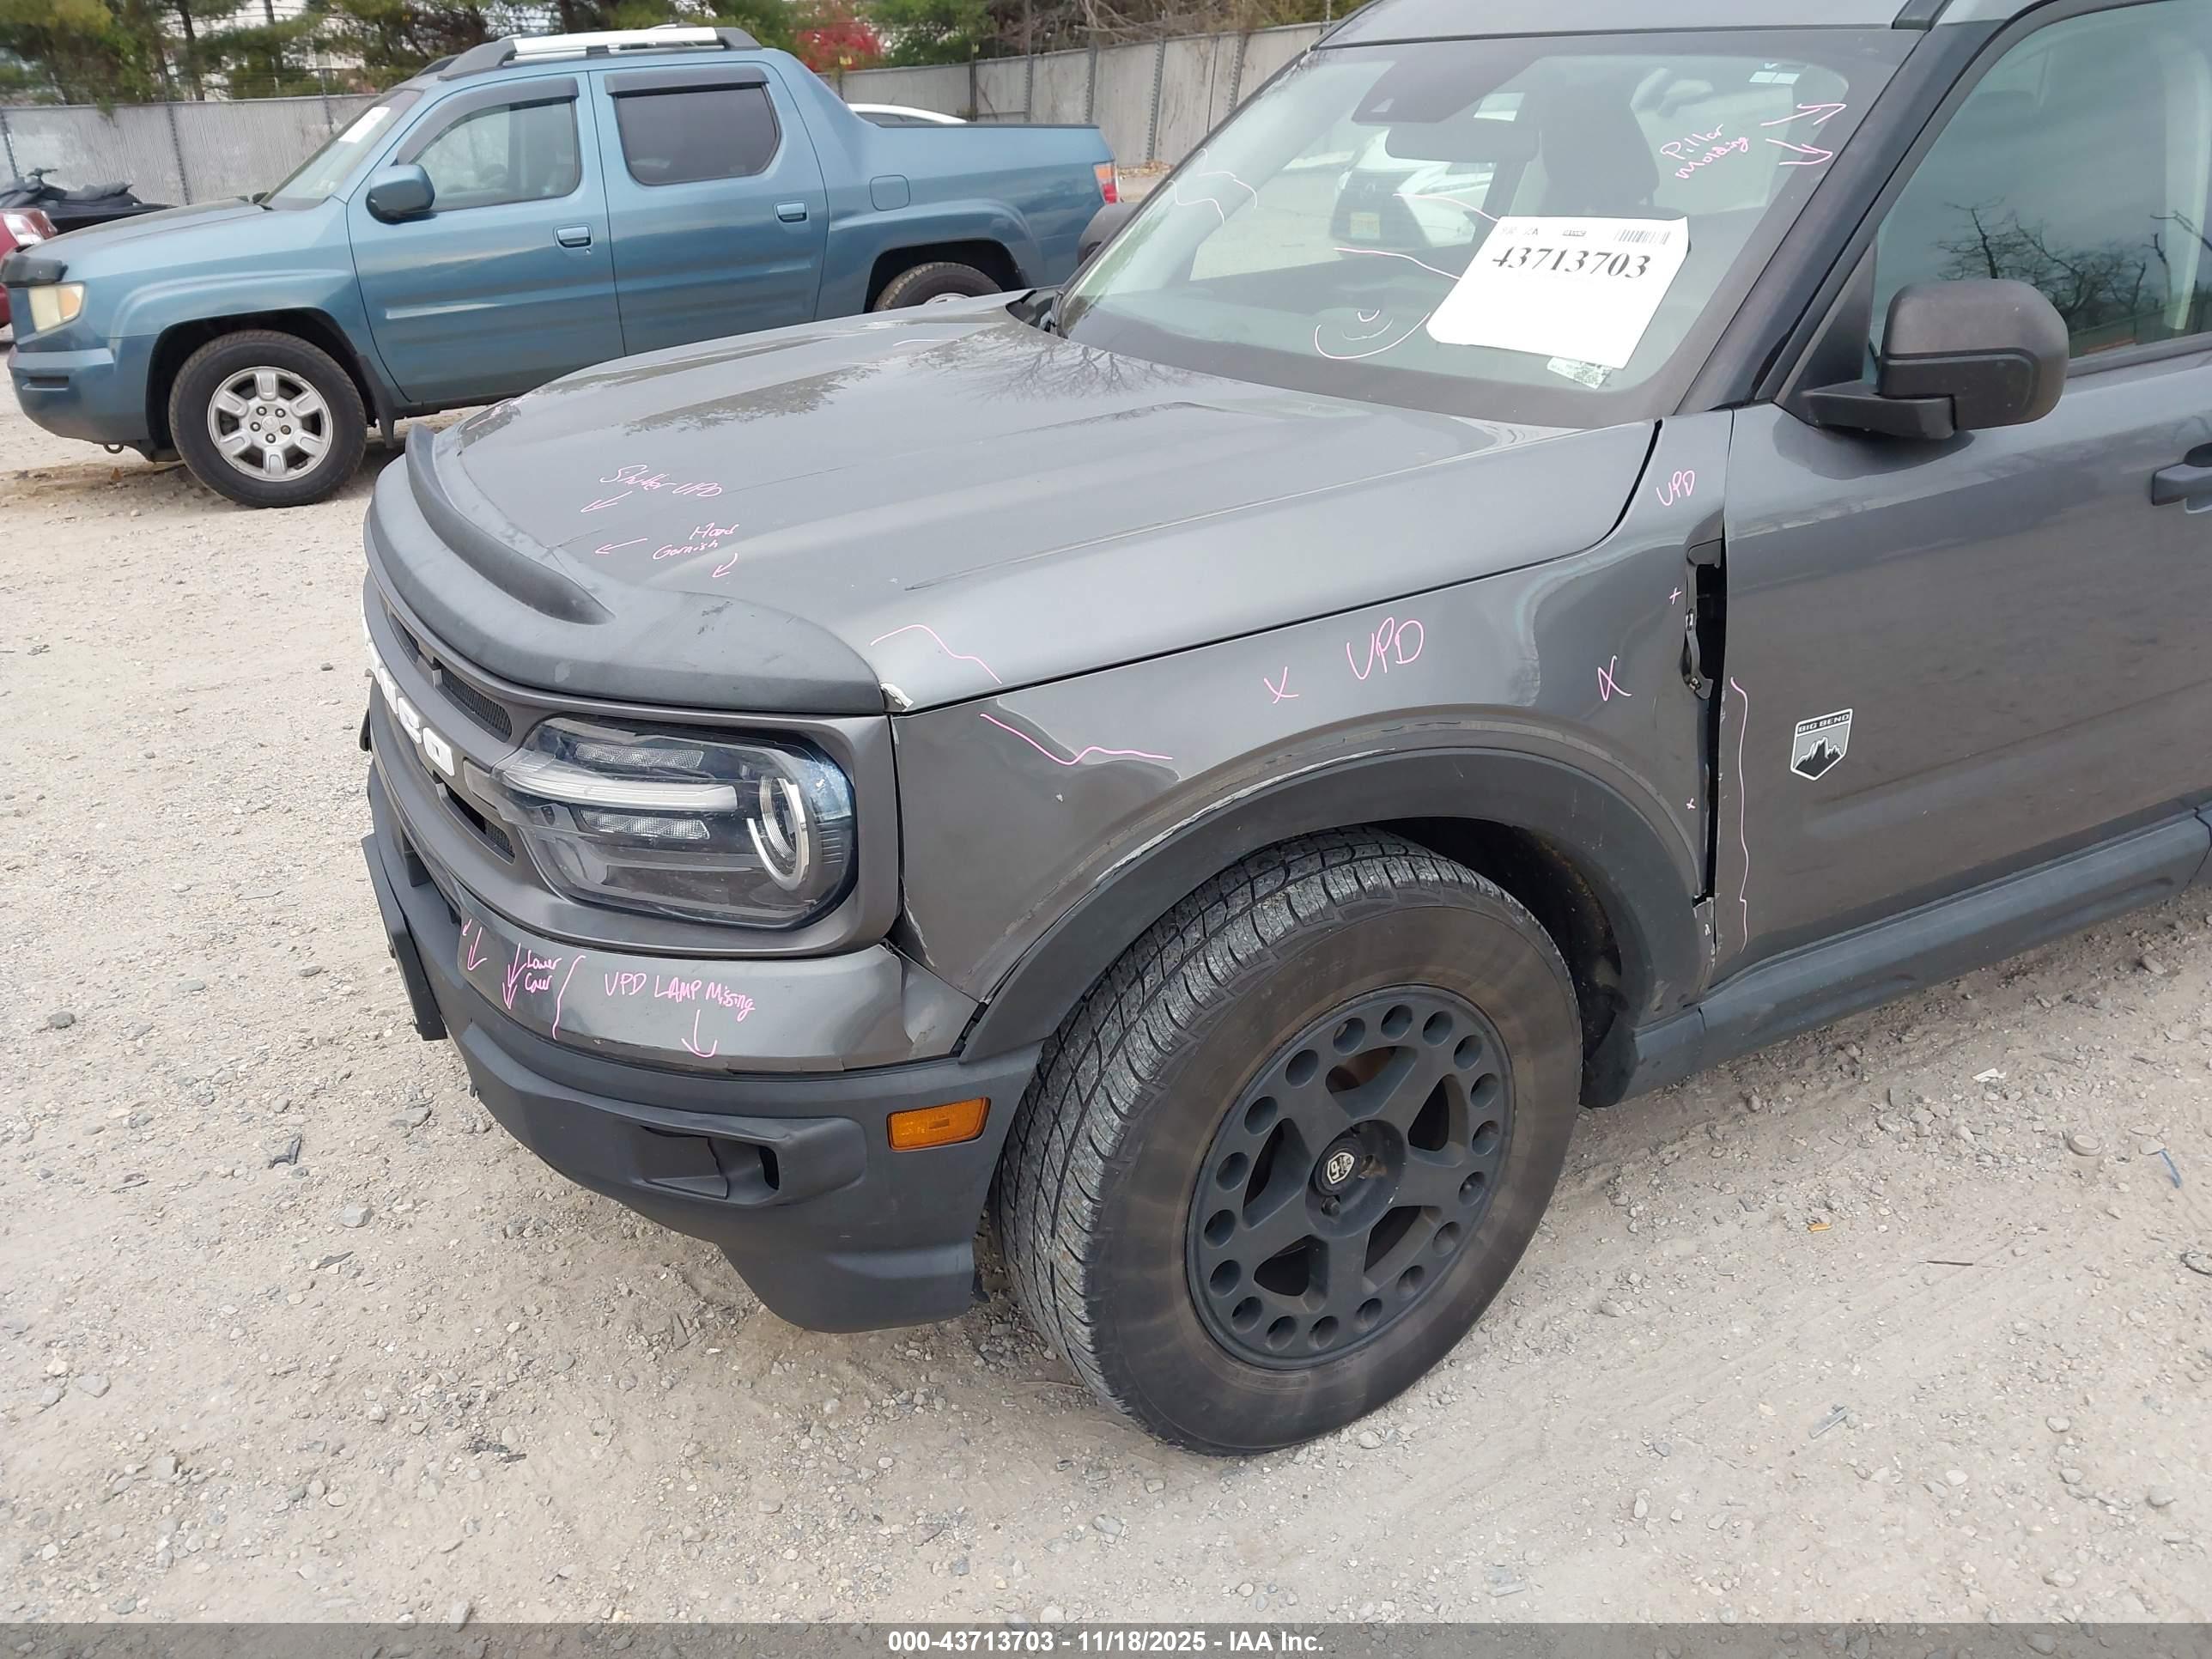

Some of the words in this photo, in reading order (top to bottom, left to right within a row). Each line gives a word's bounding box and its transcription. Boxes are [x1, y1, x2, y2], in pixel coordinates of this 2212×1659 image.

[1492, 246, 1651, 279] 43713703
[1656, 470, 1695, 507] UPD
[1346, 617, 1425, 680] UPD
[1798, 722, 1818, 732] BIG
[1819, 714, 1850, 727] BEND
[605, 971, 647, 997] UPD
[654, 975, 702, 1004] LAMP
